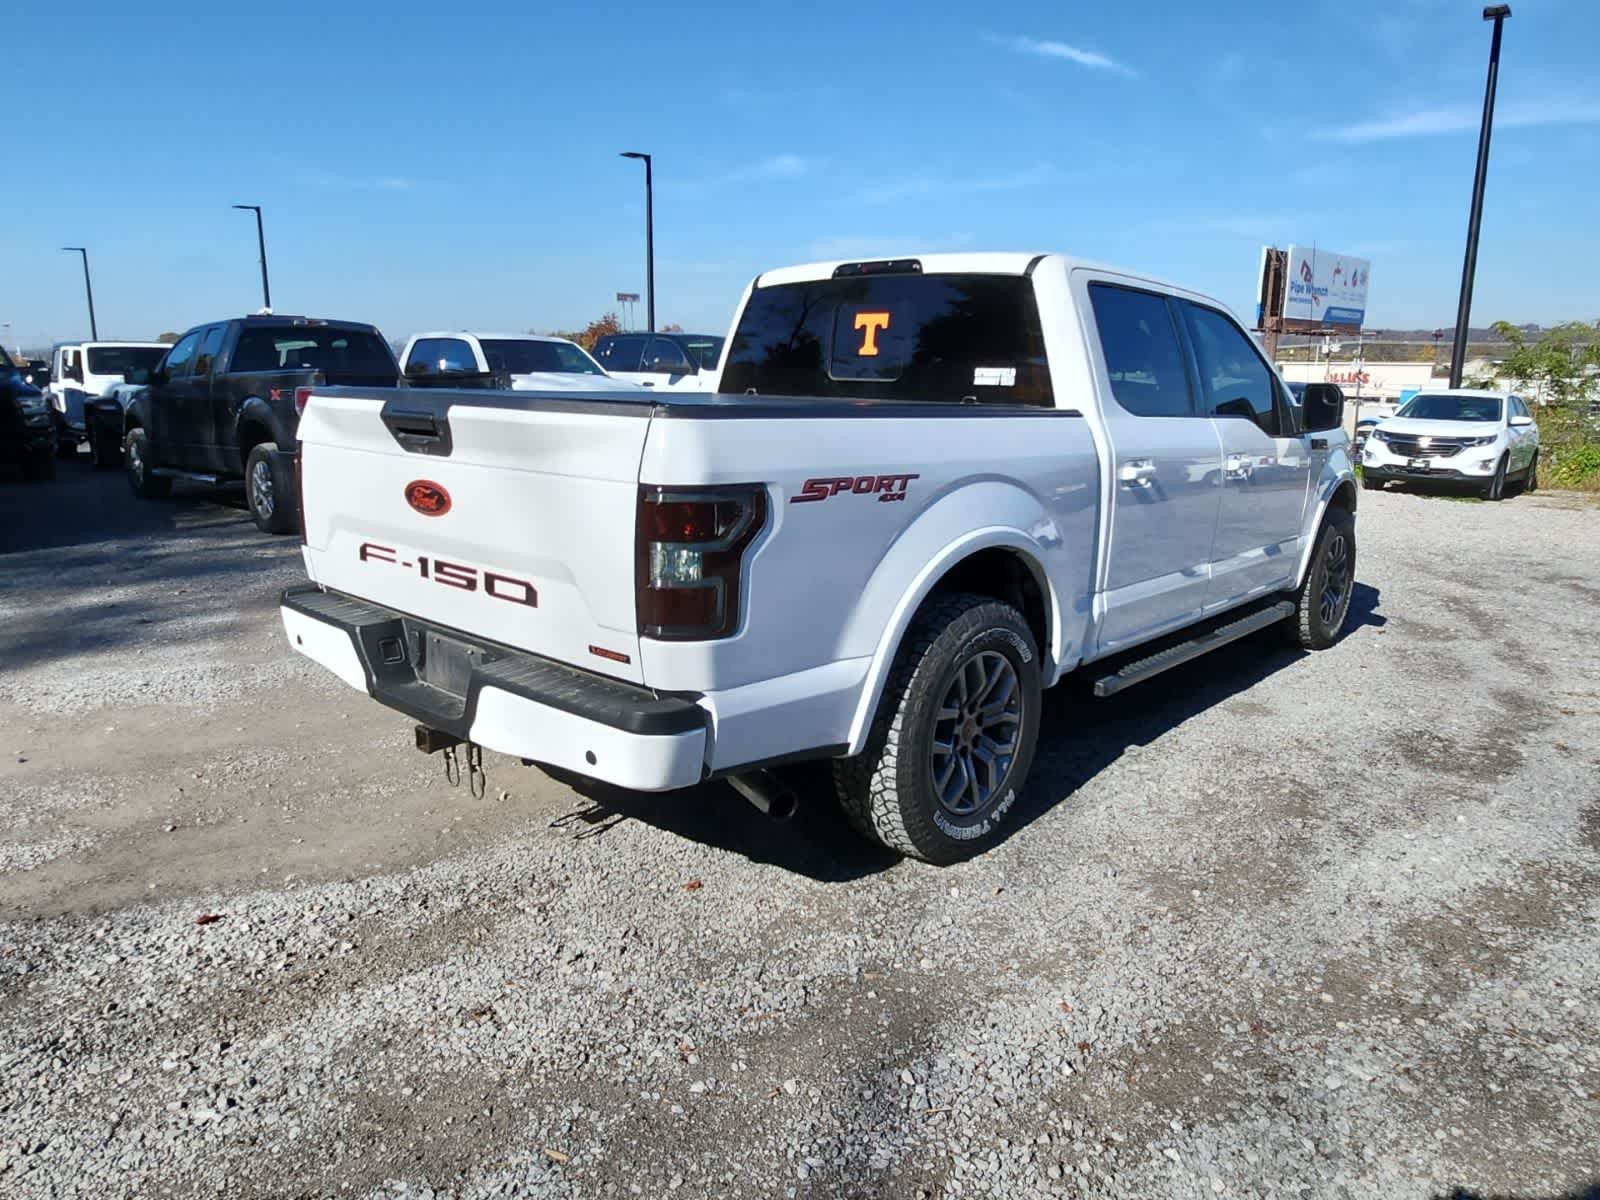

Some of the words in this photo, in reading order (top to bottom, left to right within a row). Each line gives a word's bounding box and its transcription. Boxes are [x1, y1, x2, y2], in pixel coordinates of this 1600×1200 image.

[854, 312, 890, 356] T
[789, 474, 920, 503] SPORT
[359, 542, 538, 608] F-150
